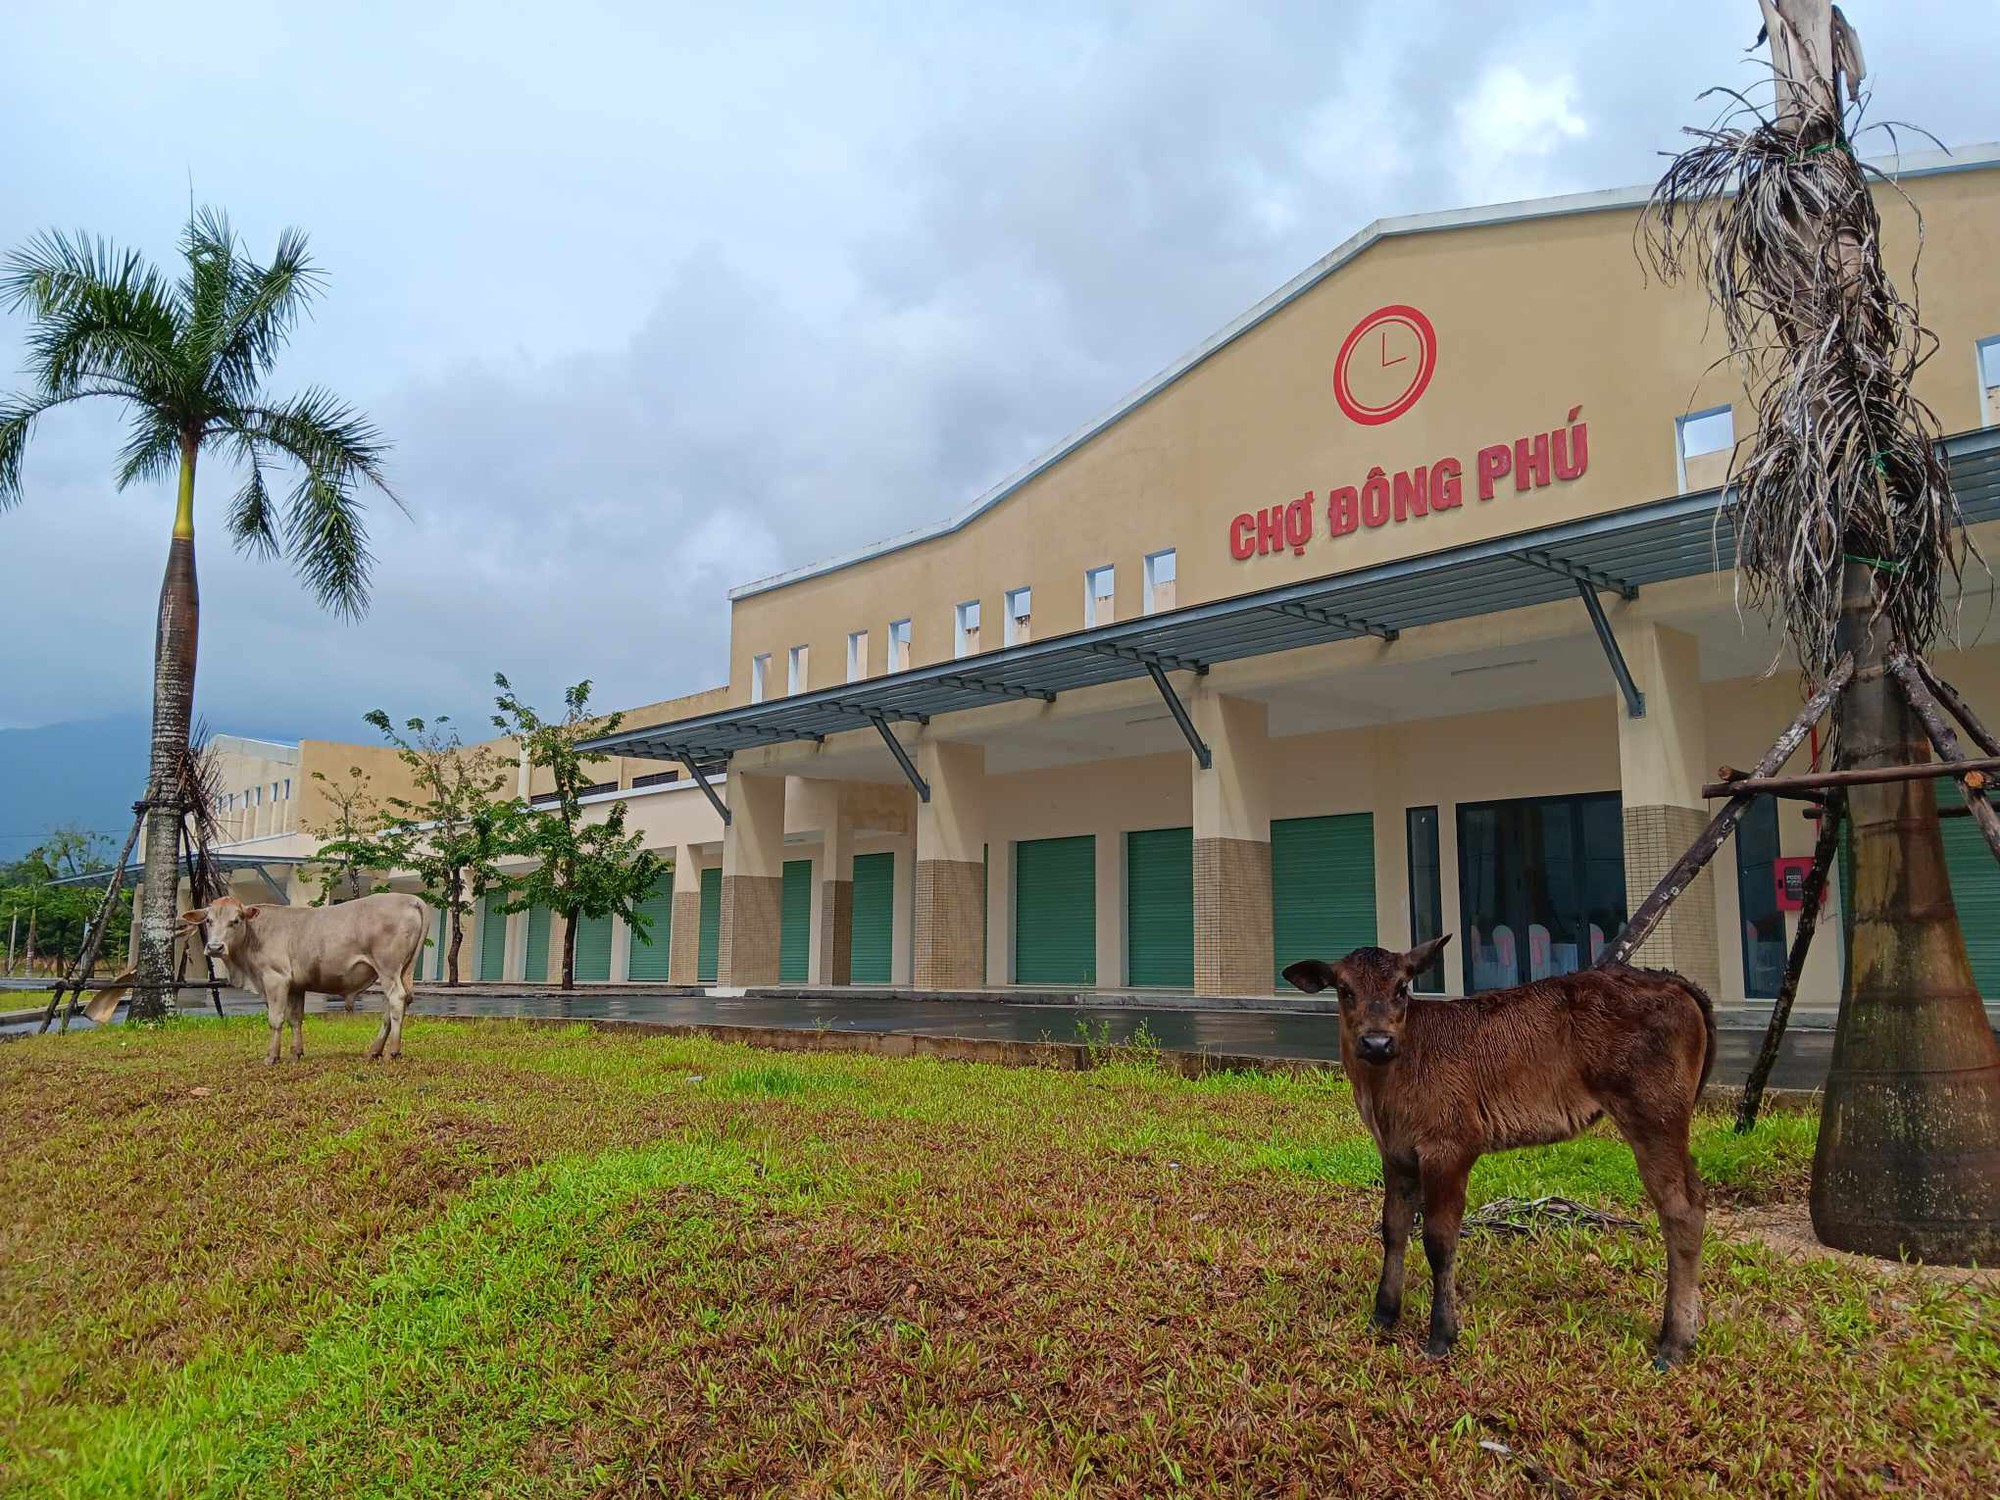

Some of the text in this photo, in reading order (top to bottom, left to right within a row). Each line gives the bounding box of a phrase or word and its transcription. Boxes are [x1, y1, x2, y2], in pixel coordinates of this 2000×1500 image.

[1230, 404, 1589, 560] CHỢ ĐÔNG PHÚ
